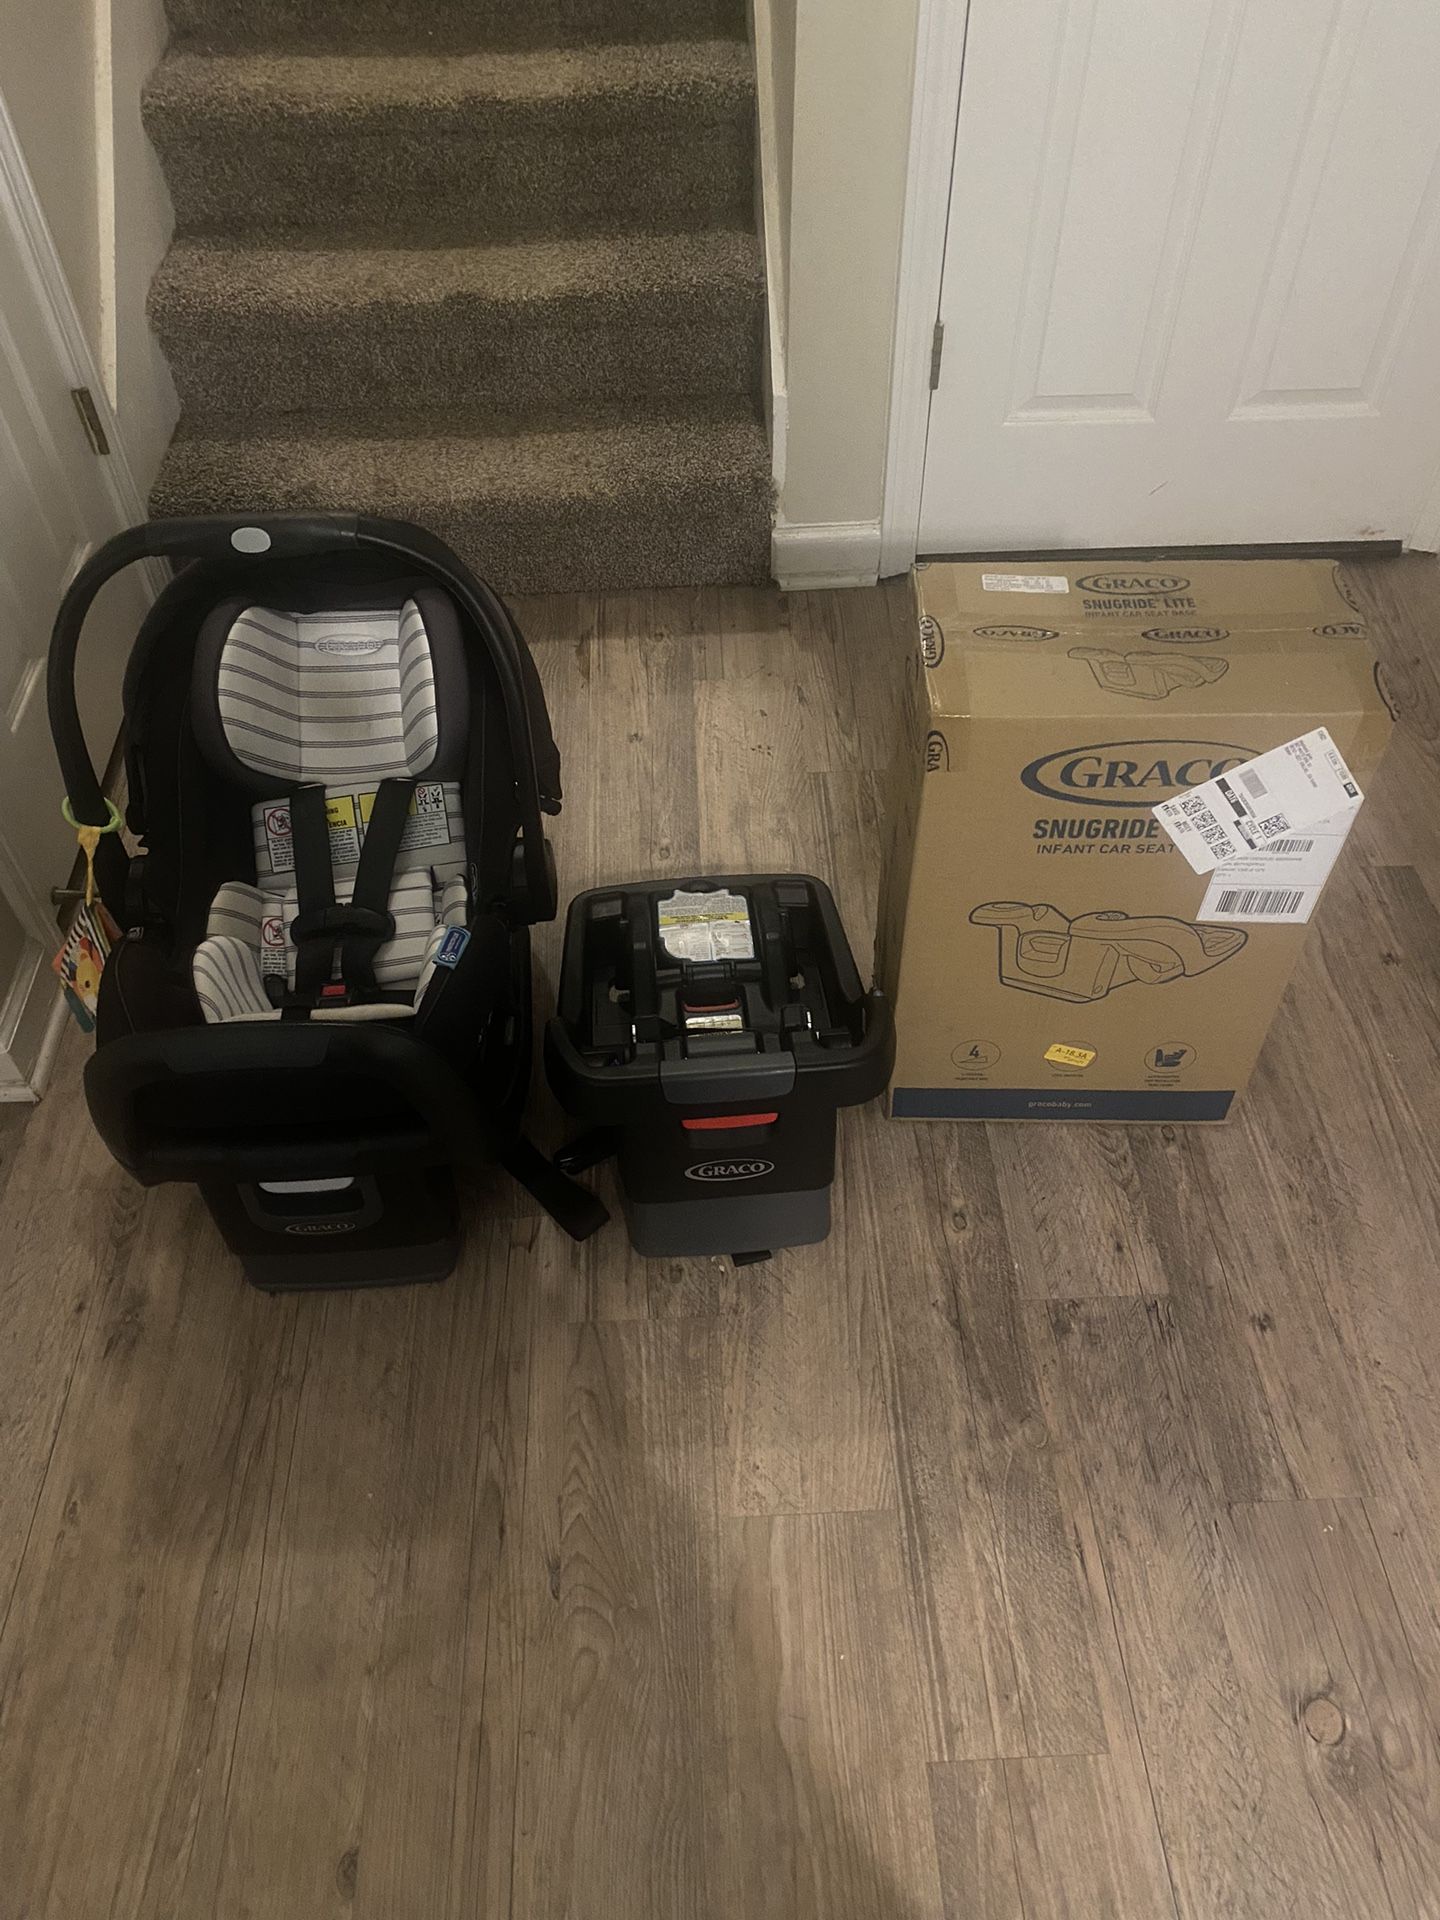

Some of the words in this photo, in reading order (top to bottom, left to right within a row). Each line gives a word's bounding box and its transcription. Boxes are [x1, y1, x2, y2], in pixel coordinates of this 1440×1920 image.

[1092, 576, 1179, 590] GRACO
[1083, 598, 1157, 610] SNUGRIDE
[1163, 597, 1197, 609] LITE
[1154, 628, 1221, 639] GRACO
[1033, 818, 1159, 839] SNUGRIDE
[1036, 844, 1098, 855] INFANT
[1100, 844, 1132, 854] CAR
[1136, 843, 1174, 854] SEAT
[969, 1044, 980, 1058] 4
[1028, 1101, 1093, 1109] gracobaby.com
[698, 1162, 766, 1177] GRACO
